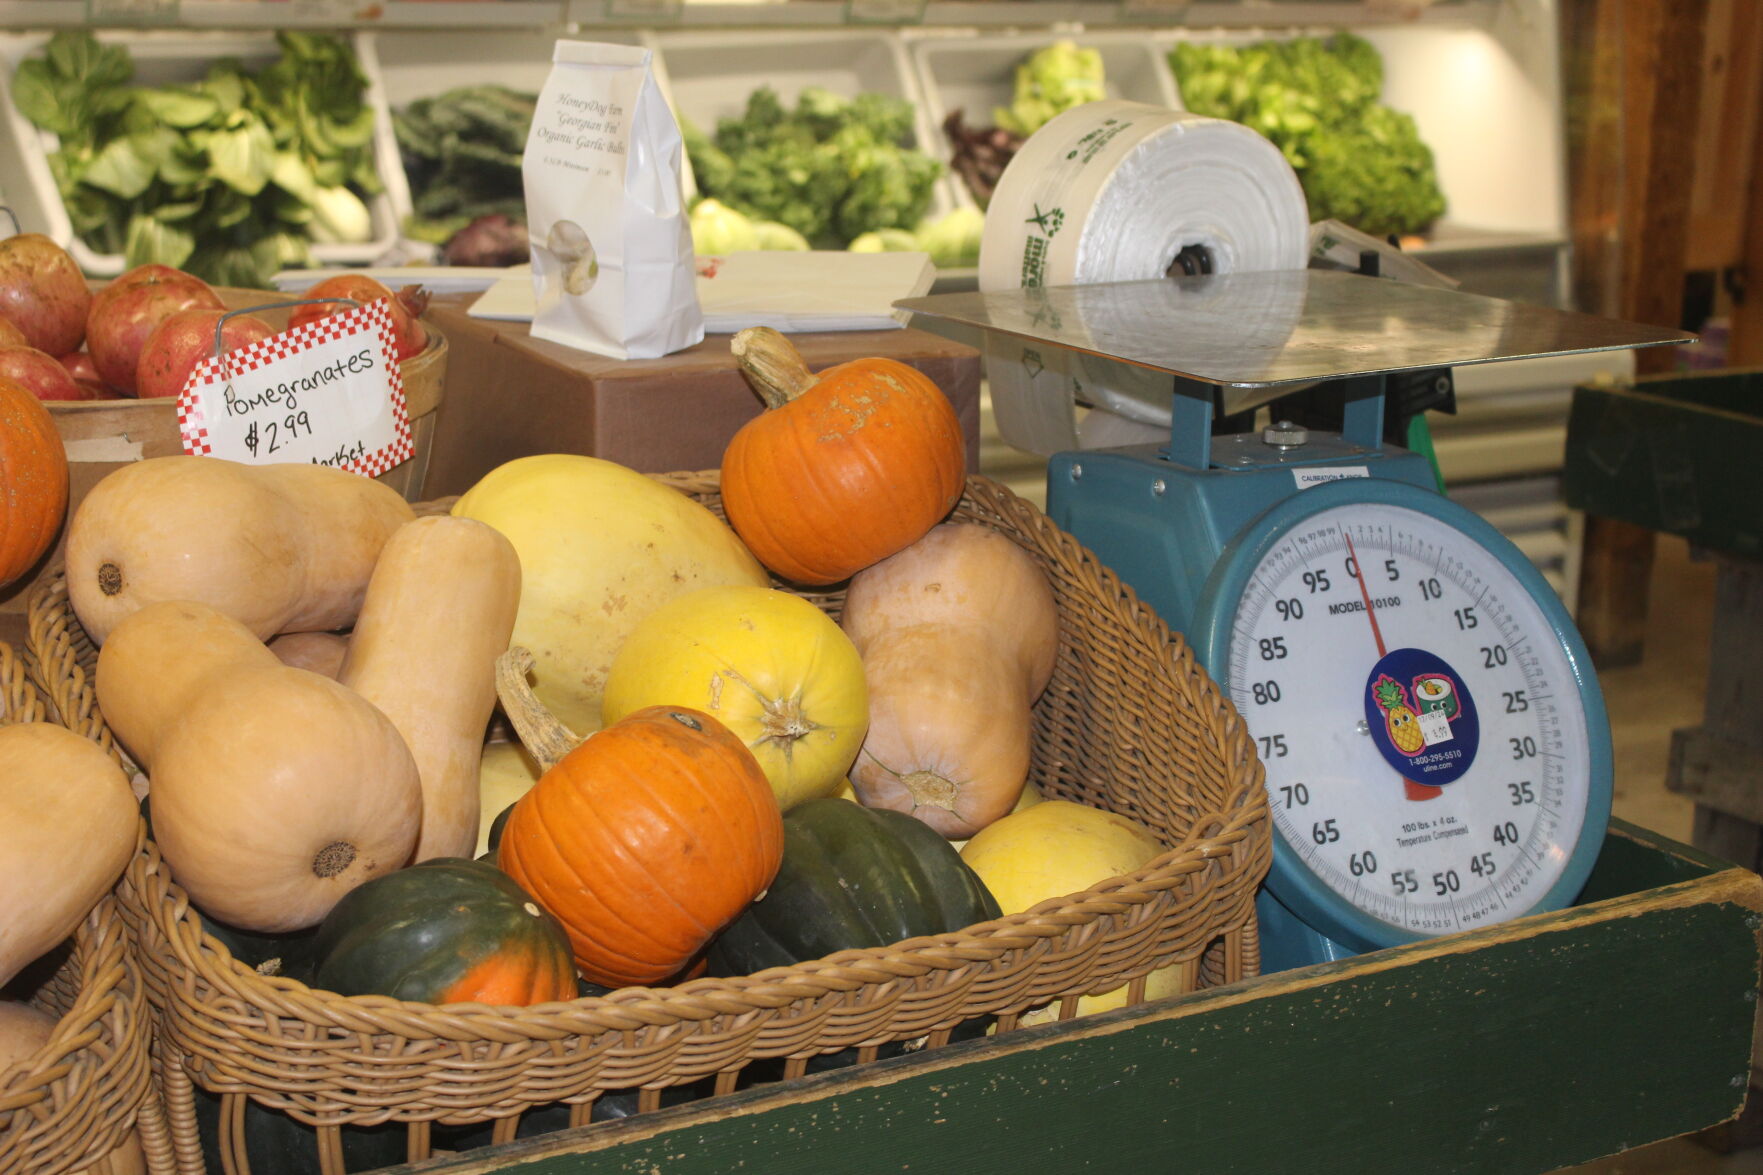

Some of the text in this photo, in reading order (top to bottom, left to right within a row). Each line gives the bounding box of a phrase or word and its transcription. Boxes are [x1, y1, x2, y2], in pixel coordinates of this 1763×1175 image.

[537, 126, 574, 144] Organic
[576, 136, 605, 150] Garlic
[1028, 237, 1044, 288] more
[223, 349, 374, 417] Pomegranates
[244, 410, 312, 458] $2.99
[1302, 569, 1331, 594] 95
[1385, 560, 1399, 581] 5
[1418, 578, 1442, 601] 10
[1275, 598, 1304, 622] 90
[1328, 596, 1401, 615] MODEL 10100
[1454, 607, 1478, 631] 15
[1258, 636, 1288, 661] 85
[1480, 644, 1507, 669] 20
[1252, 680, 1281, 706] 80
[1502, 690, 1528, 714] 25
[1258, 734, 1289, 760] 75
[1408, 749, 1462, 767] 1-800-295-5510
[1509, 735, 1536, 760] 30
[1423, 761, 1453, 773] uline.com
[1280, 783, 1309, 809] 70
[1507, 781, 1535, 806] 35
[1312, 818, 1340, 845] 65
[1402, 822, 1417, 834] 100
[1493, 821, 1519, 847] 40
[1350, 850, 1377, 876] 60
[1470, 851, 1496, 877] 45
[1391, 868, 1419, 896] 55
[1432, 869, 1460, 896] 50
